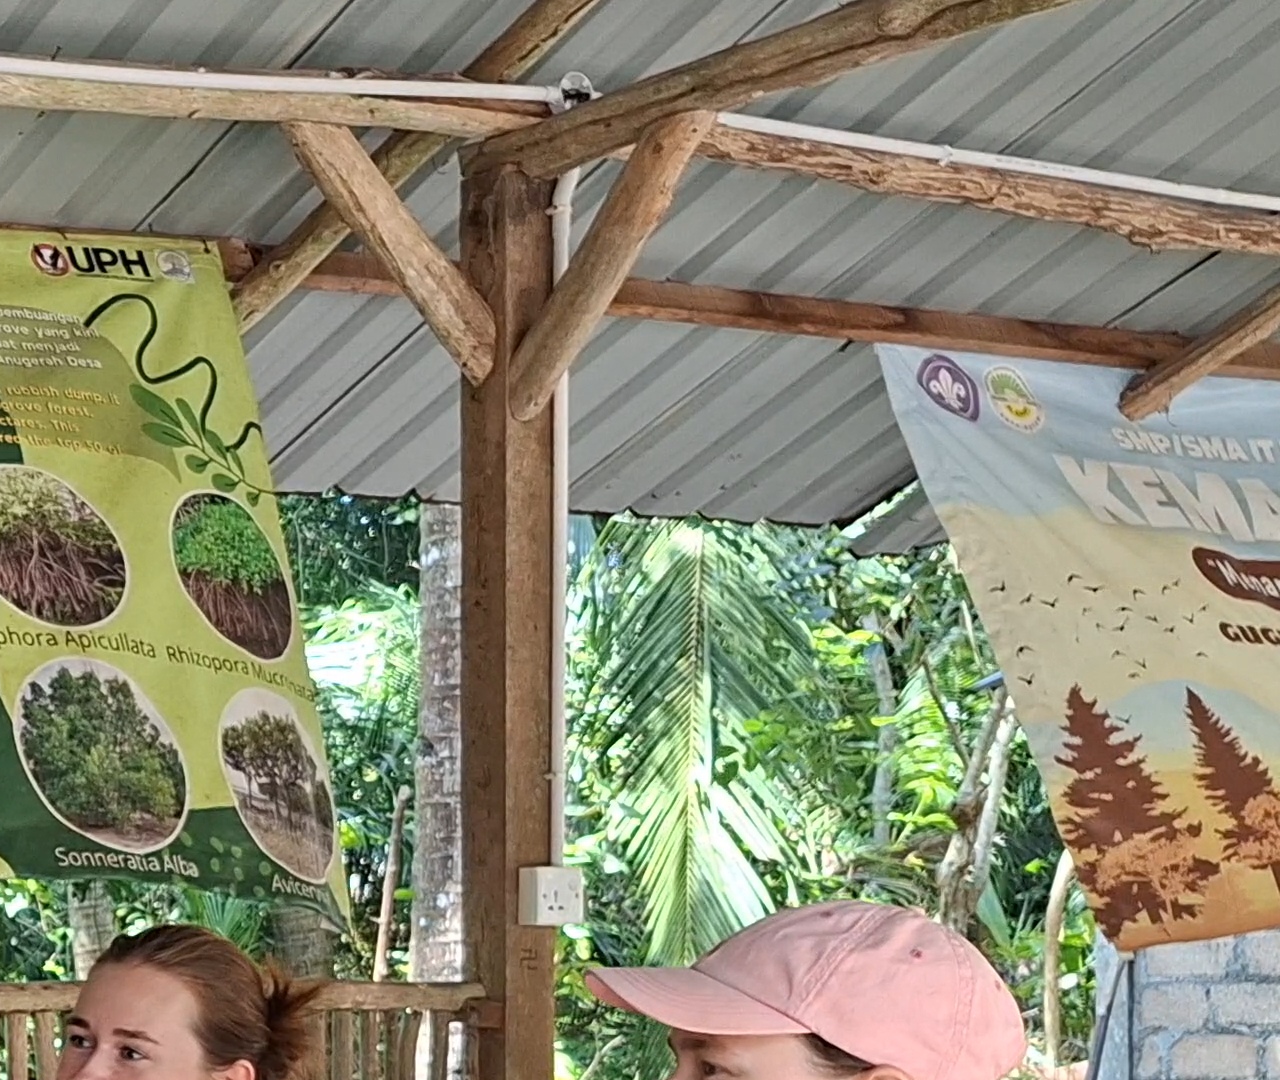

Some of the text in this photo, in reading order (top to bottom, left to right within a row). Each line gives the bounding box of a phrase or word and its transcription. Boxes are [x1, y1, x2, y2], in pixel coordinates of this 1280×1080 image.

[65, 245, 152, 278] UPH
[1248, 437, 1276, 464] IT
[64, 629, 157, 660] Apicullata
[165, 645, 250, 677] Rhizopora
[55, 845, 200, 879] Sonneratia Alba
